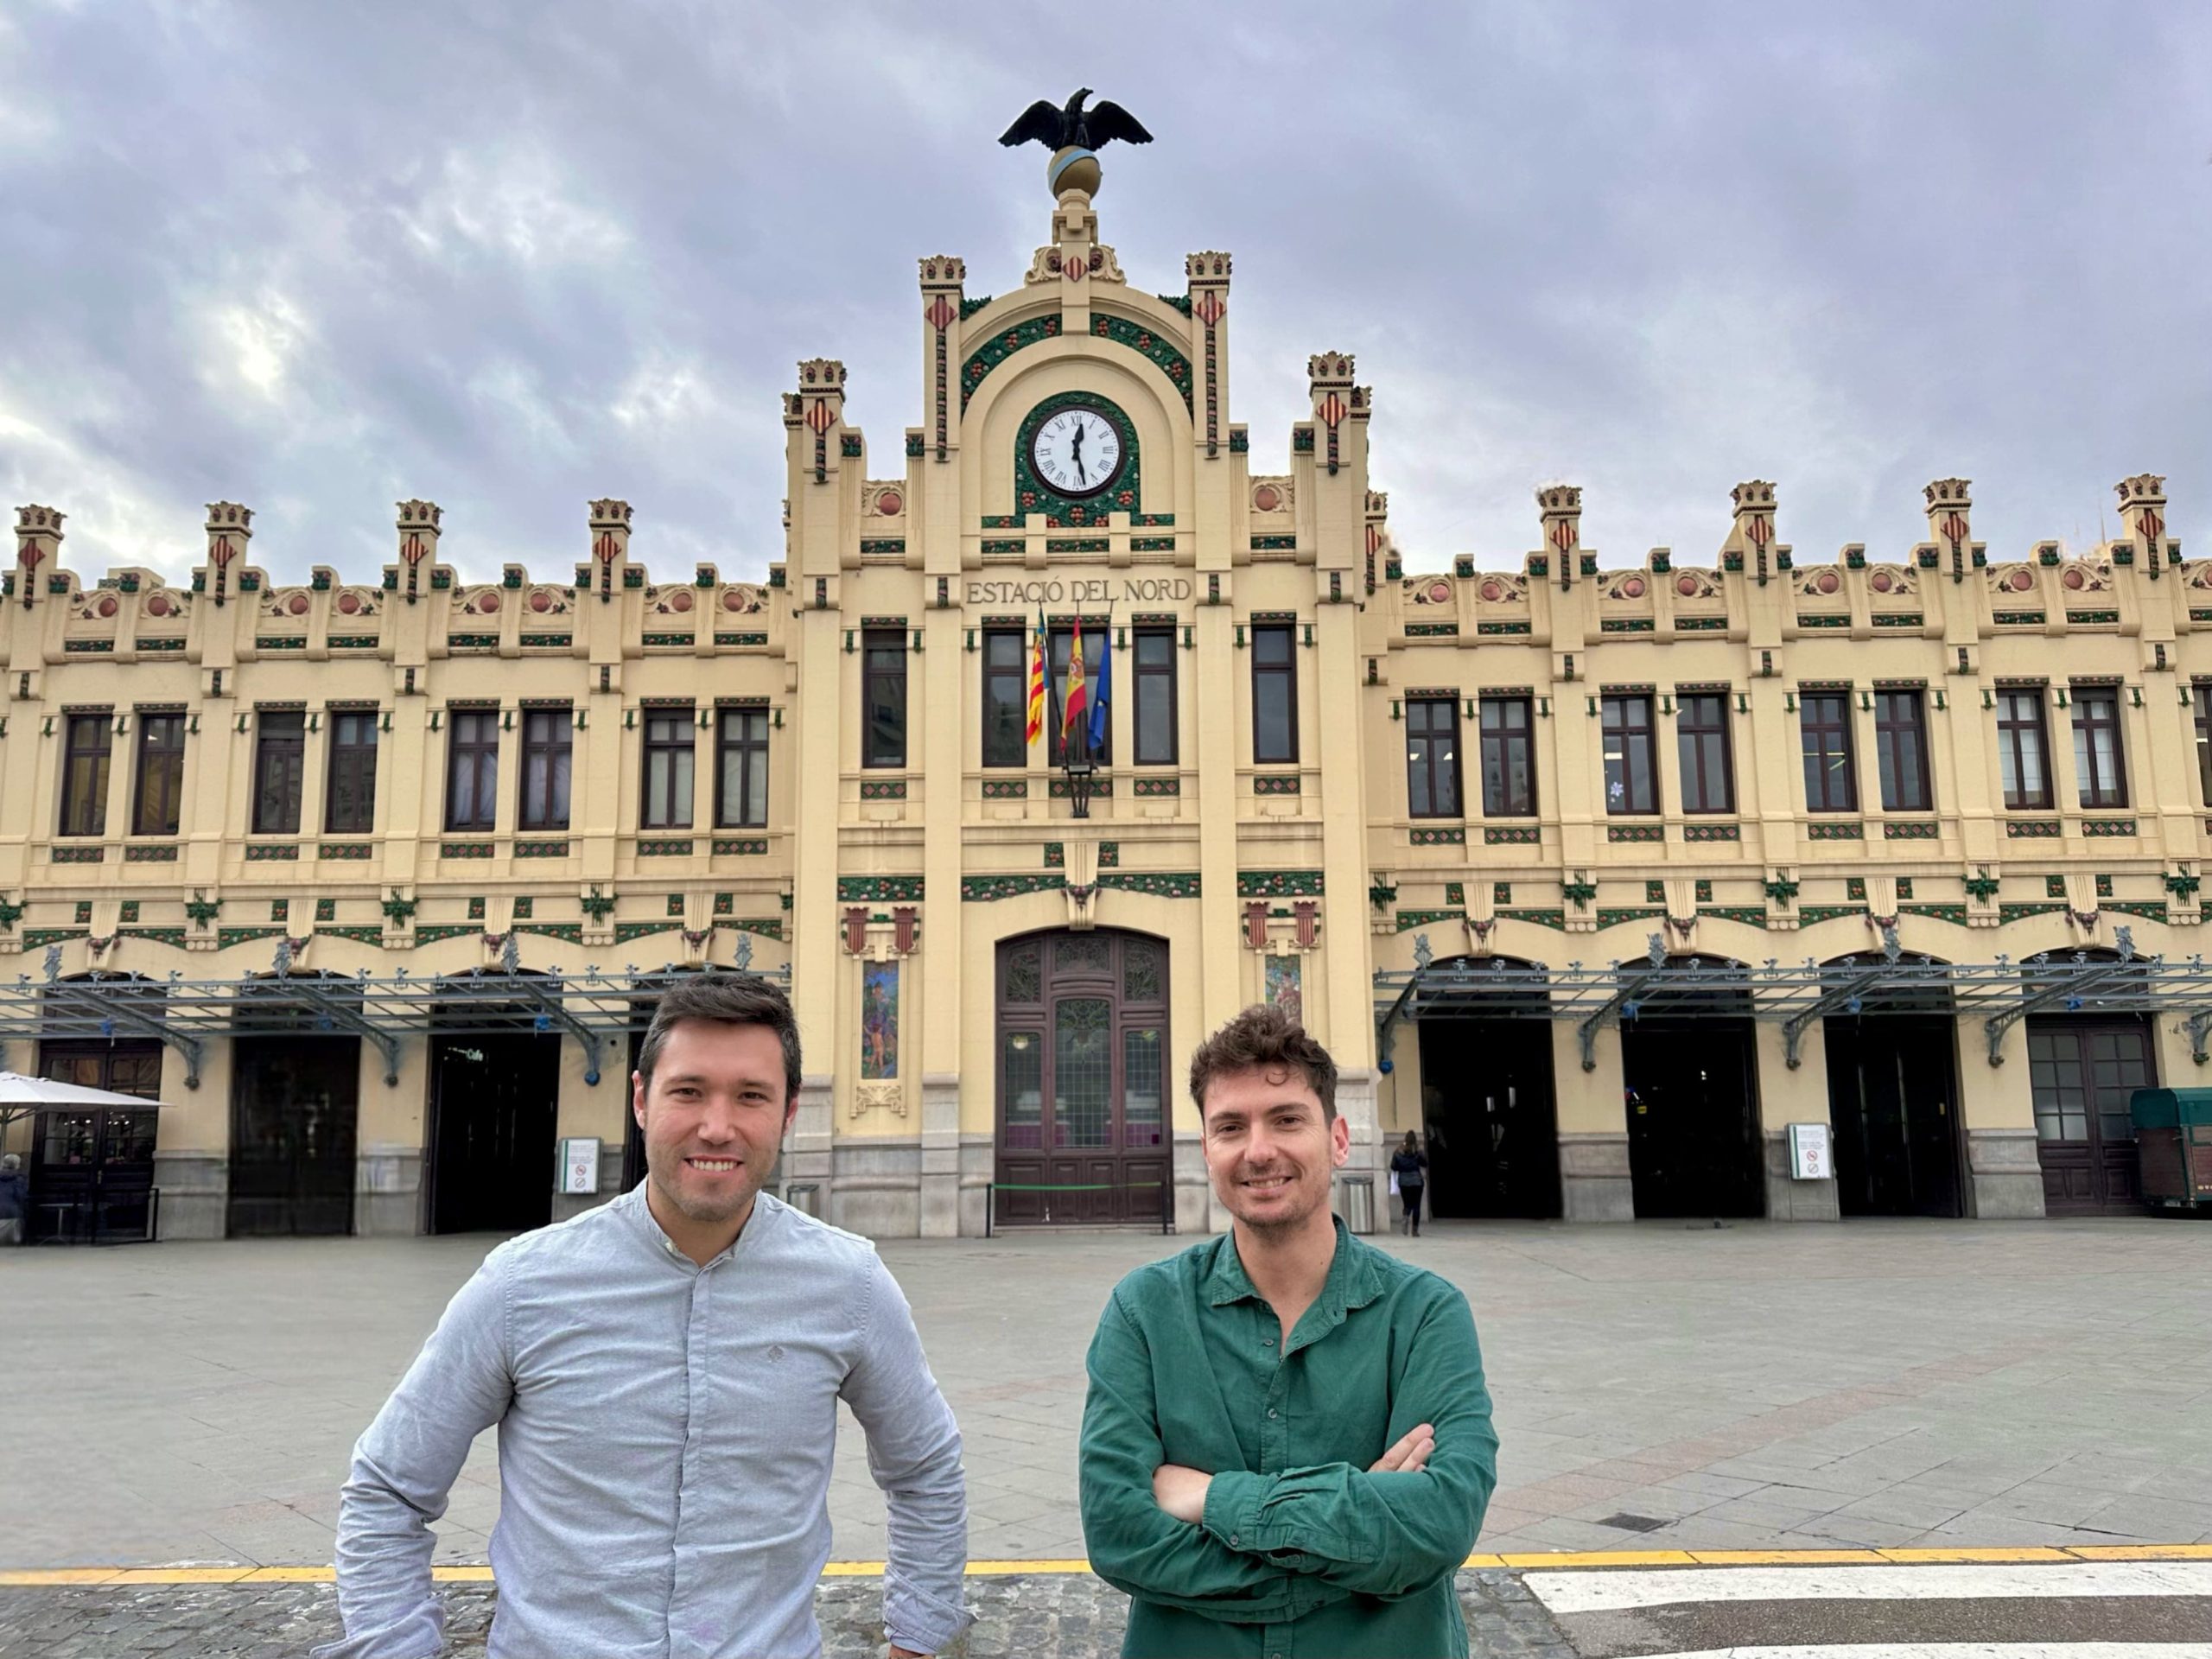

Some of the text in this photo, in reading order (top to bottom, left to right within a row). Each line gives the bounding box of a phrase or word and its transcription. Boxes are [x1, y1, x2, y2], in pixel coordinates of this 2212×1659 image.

[966, 575, 1192, 603] ESTACIÓ DEL NORD
